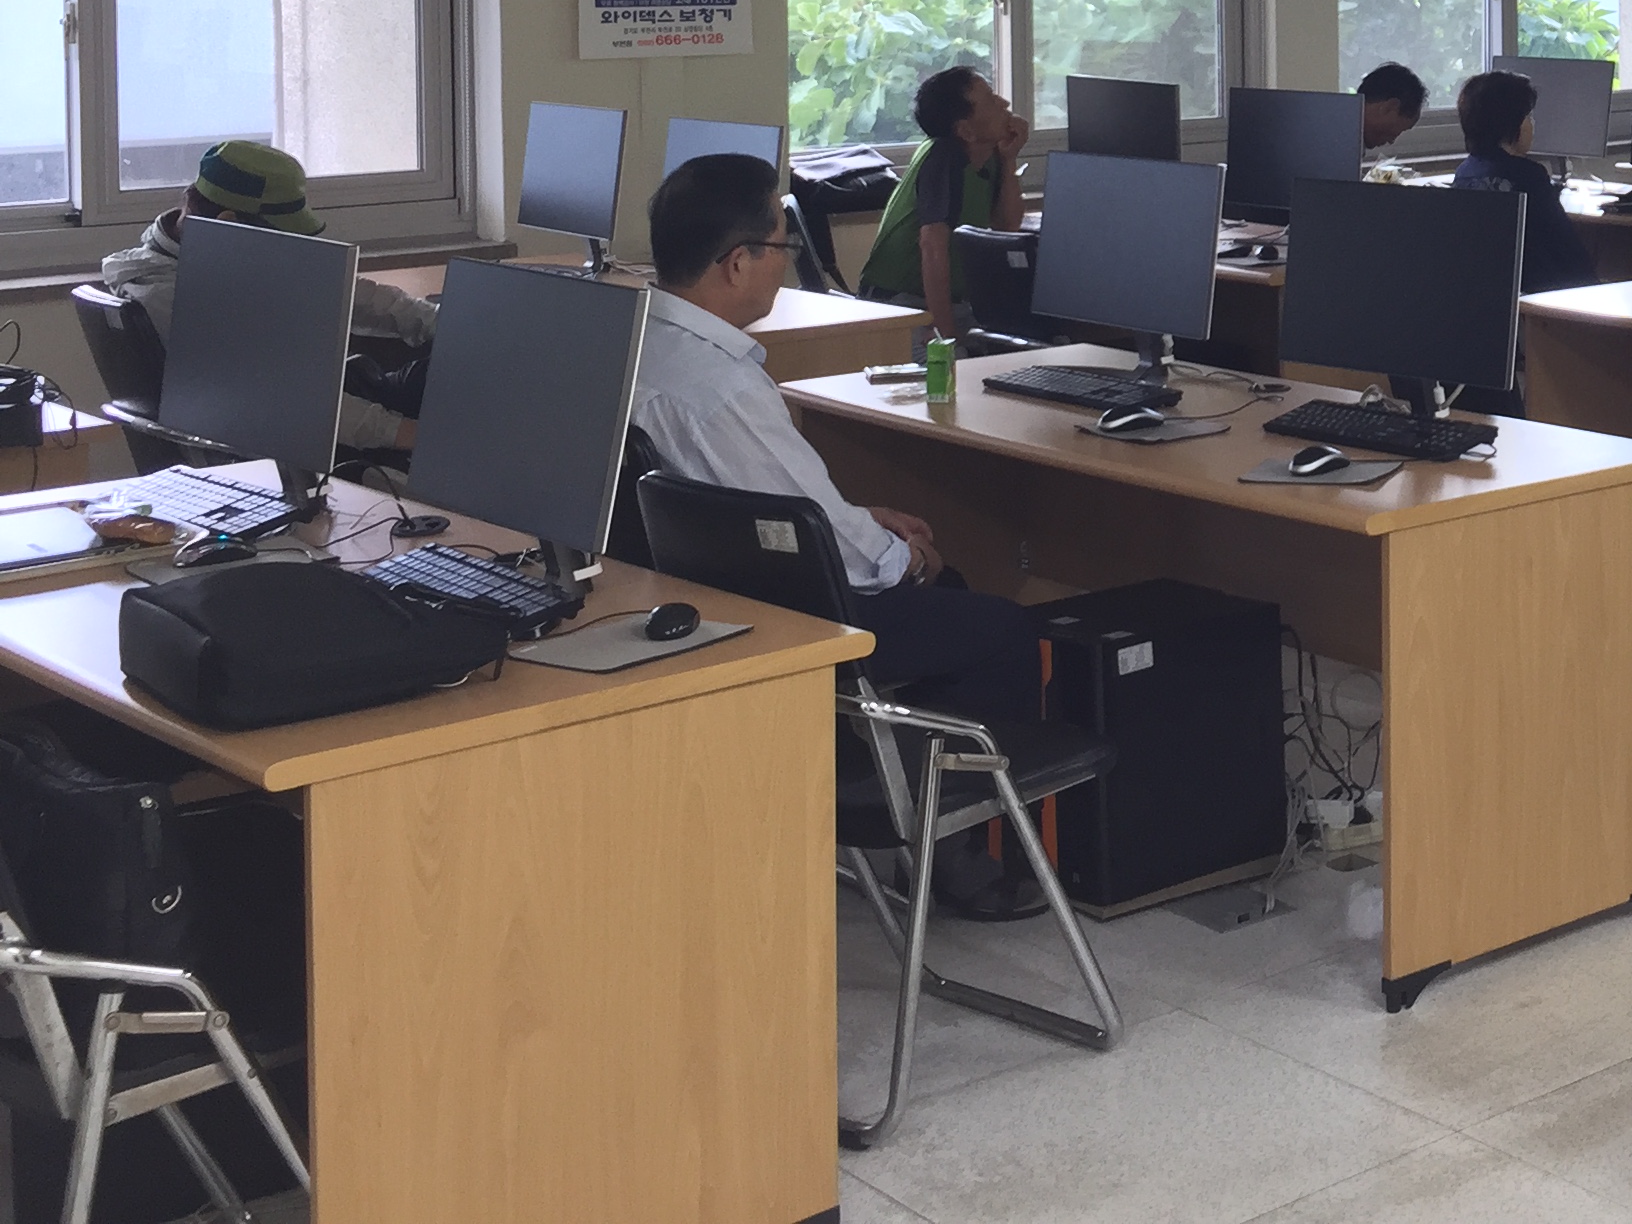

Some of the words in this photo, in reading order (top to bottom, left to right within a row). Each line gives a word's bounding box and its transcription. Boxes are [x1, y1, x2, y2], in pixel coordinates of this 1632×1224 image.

[601, 9, 675, 24] 와이덱스
[680, 8, 732, 23] 보청기
[655, 33, 724, 46] 666-0128
